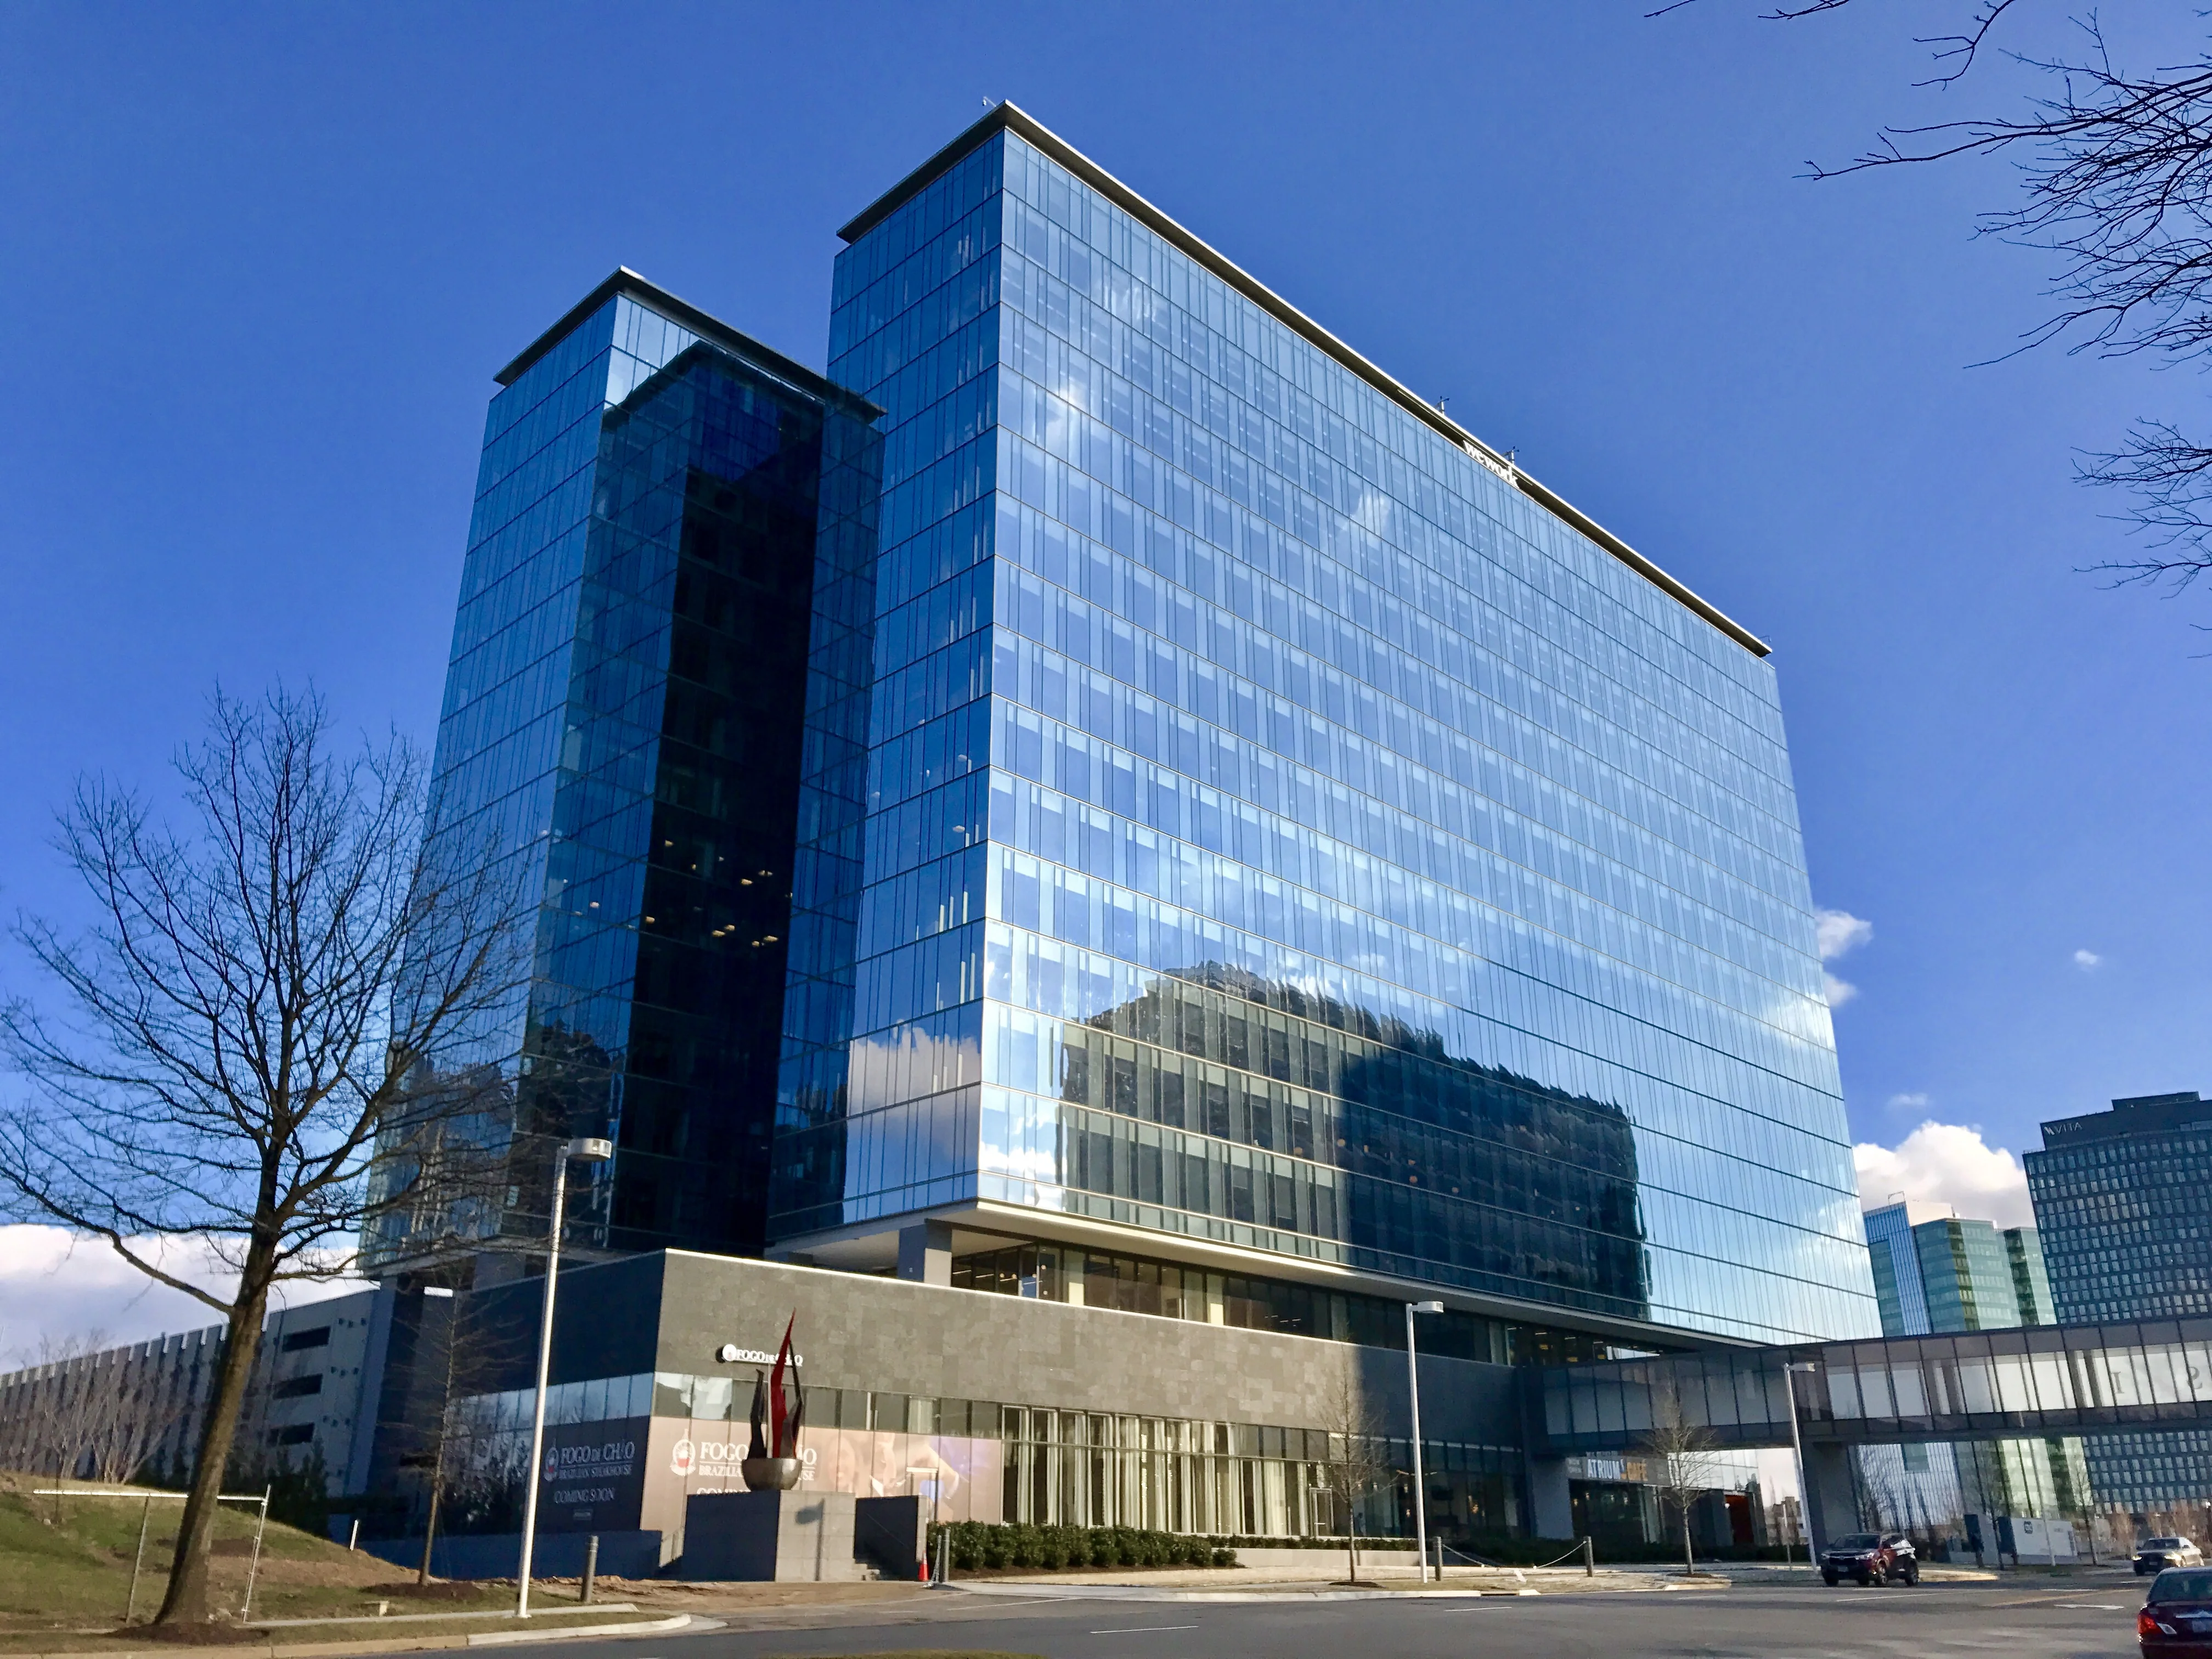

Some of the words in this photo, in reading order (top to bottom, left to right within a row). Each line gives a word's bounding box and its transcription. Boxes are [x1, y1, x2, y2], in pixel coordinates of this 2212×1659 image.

[737, 1349, 765, 1362] FOGO
[561, 1446, 591, 1464] FOGO
[700, 1442, 749, 1462] FOGO
[698, 1465, 742, 1477] BRAZILIA
[1587, 1459, 1621, 1480] ATRIUM
